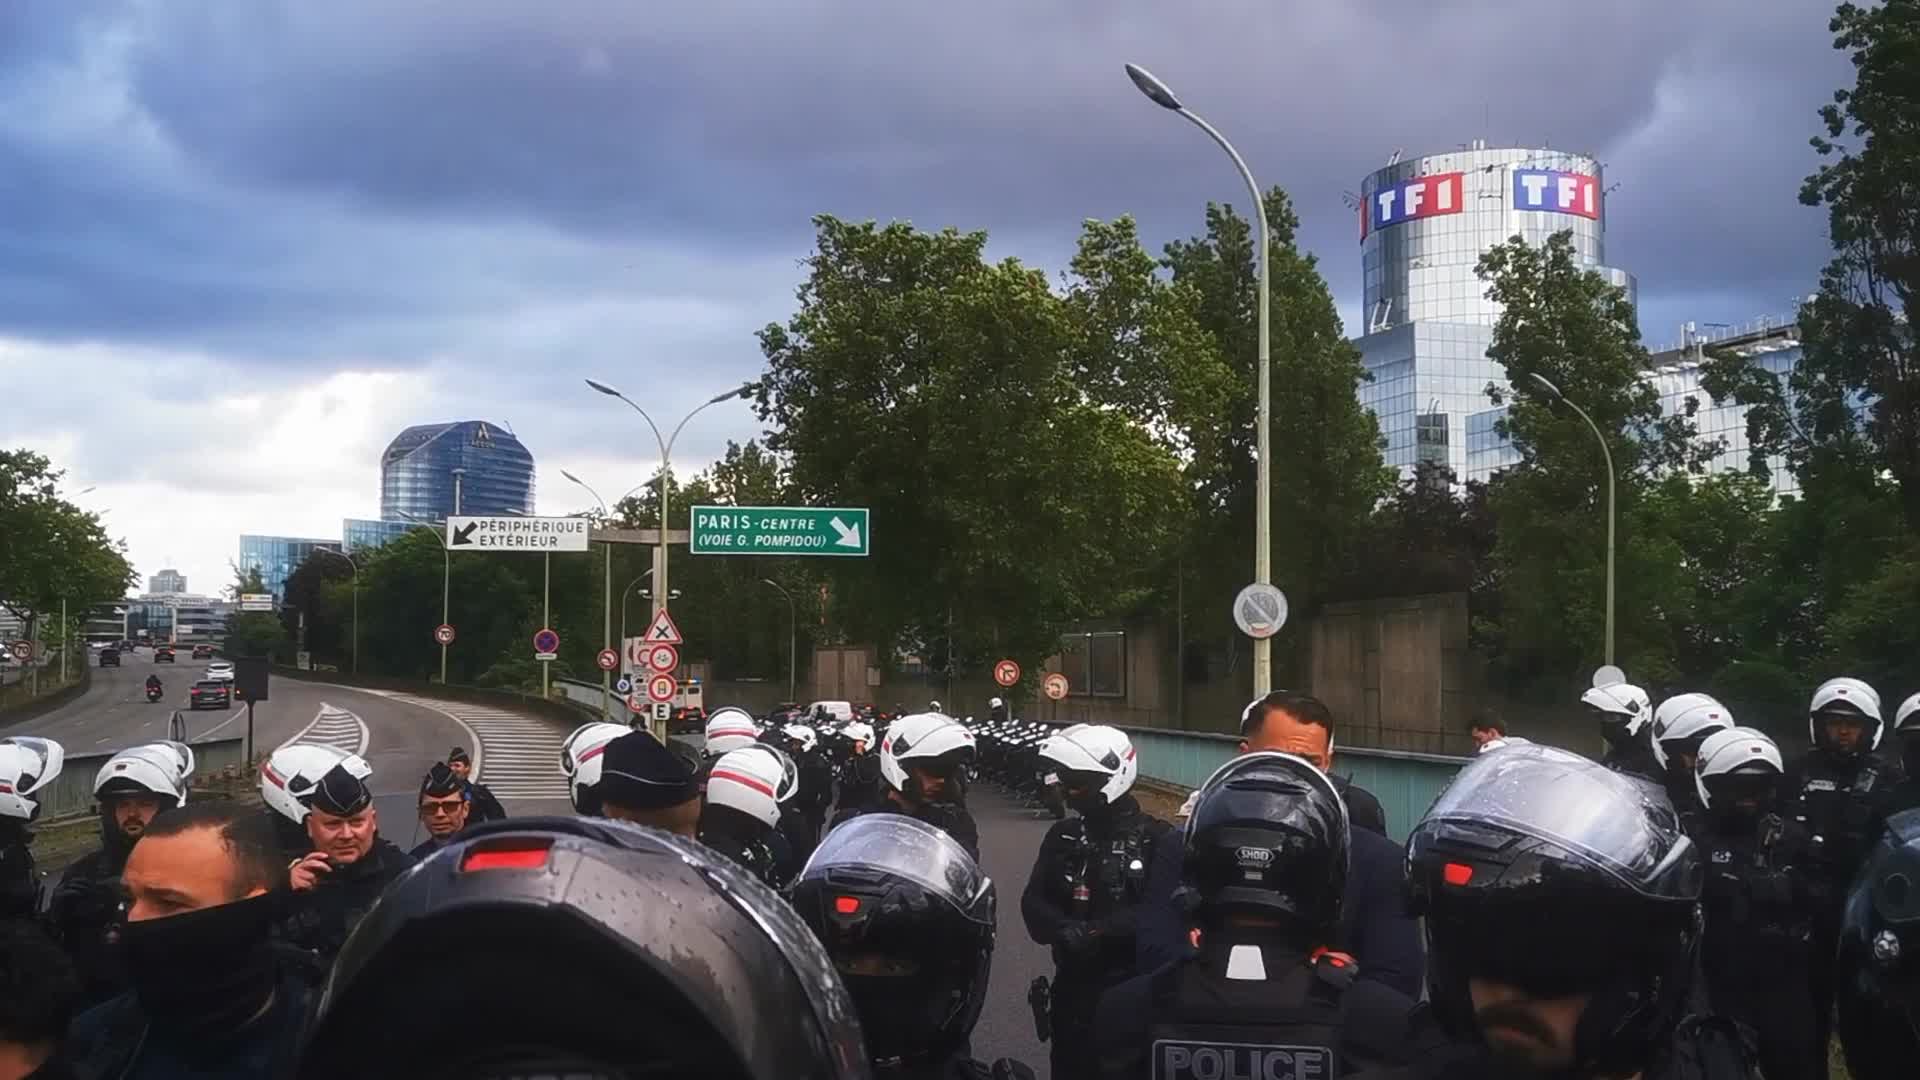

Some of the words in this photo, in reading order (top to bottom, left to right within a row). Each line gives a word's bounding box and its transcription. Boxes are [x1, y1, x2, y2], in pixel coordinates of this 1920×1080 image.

[1378, 177, 1453, 222] TF1
[1522, 174, 1593, 213] TF1
[480, 518, 584, 533] PÉRIPHÉRIQUE
[480, 533, 558, 547] EXTÉRIEUR
[737, 534, 750, 547] G.
[754, 534, 827, 548] POMPIDOU)
[656, 704, 666, 719] E
[1165, 1046, 1322, 1080] POLICE
